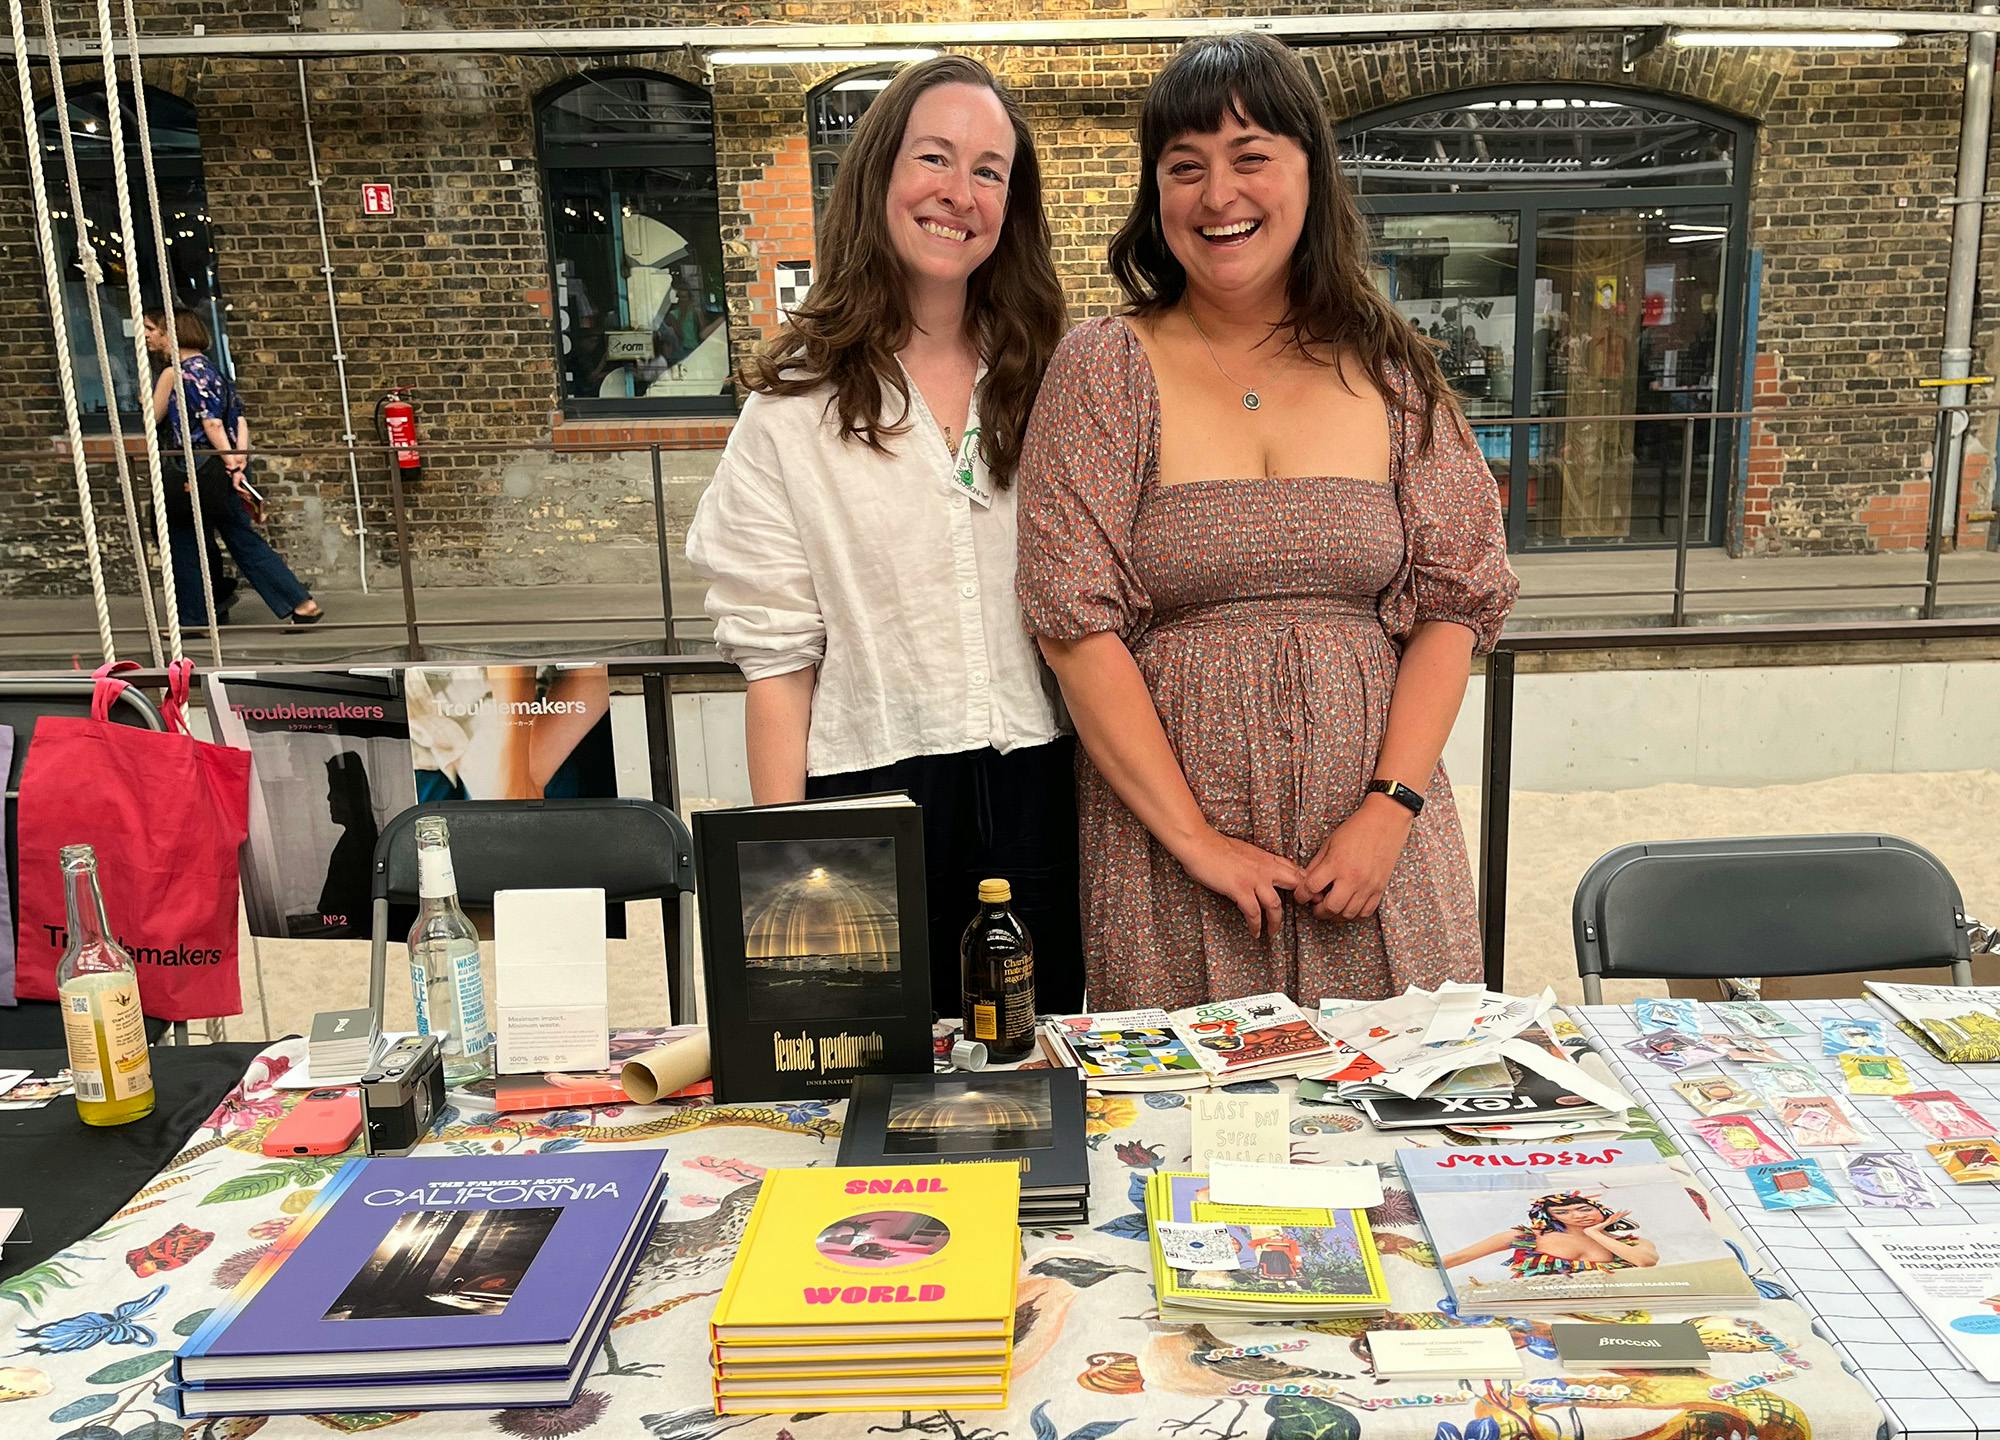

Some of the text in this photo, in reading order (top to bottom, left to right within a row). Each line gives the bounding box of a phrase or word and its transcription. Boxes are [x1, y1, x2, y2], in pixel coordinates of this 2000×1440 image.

[230, 702, 385, 720] Troublemakers
[774, 1030, 884, 1075] female pentimento
[1200, 1099, 1279, 1128] LAST DAY
[1216, 1129, 1256, 1147] SUPER
[1436, 1149, 1625, 1168] MILDEW
[464, 1179, 532, 1187] FAMILY
[844, 1178, 949, 1194] SNAIL
[364, 1182, 620, 1206] CALIFORNIA
[1881, 1243, 1968, 1252] Discover
[803, 1284, 946, 1305] WORLD
[1230, 1384, 1341, 1399] MILDEW
